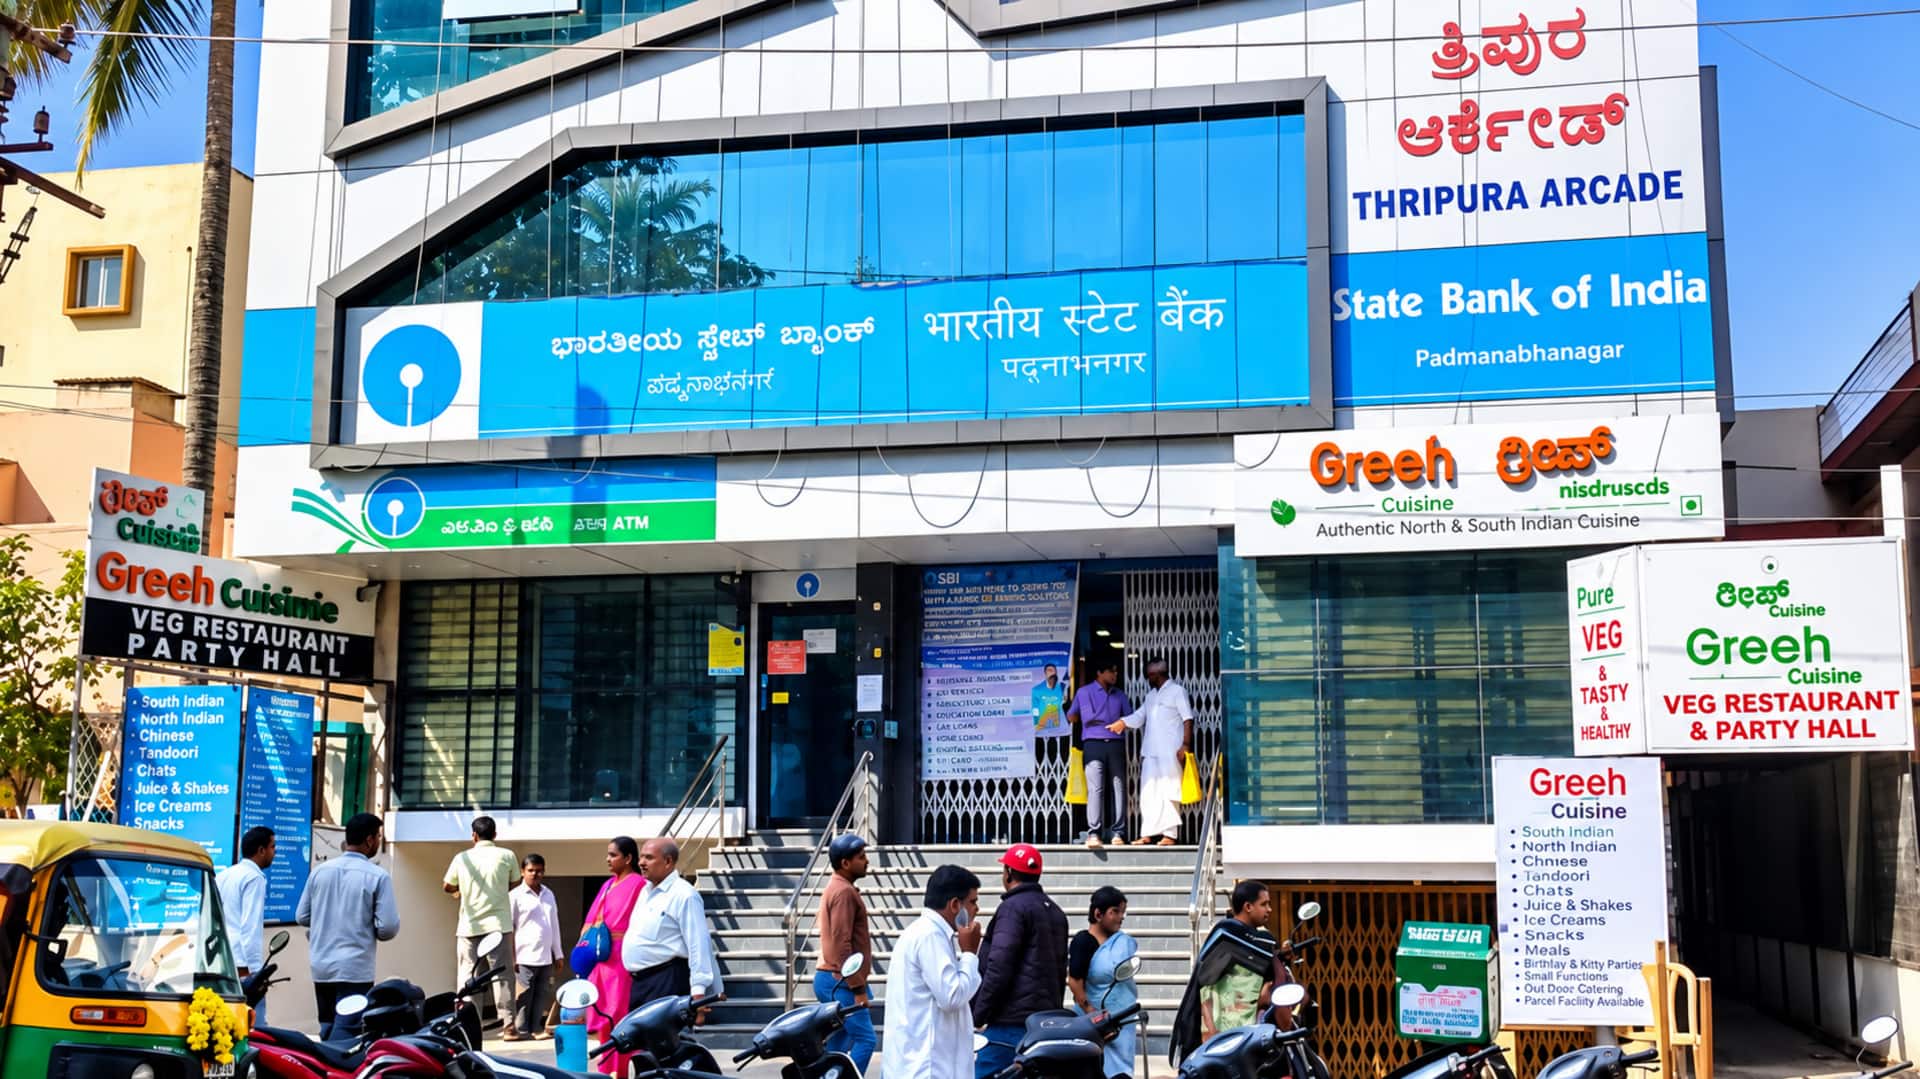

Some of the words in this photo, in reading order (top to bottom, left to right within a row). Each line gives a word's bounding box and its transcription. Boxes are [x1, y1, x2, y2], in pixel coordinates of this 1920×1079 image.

[1352, 180, 1529, 221] THRIPURA
[1540, 170, 1683, 208] ARCADE
[1333, 287, 1424, 321] State
[1440, 278, 1540, 317] Bank
[1551, 274, 1592, 310] of
[1610, 269, 1707, 308] India
[924, 296, 1044, 342] भारतीय
[1059, 290, 1139, 336] स्टेट
[1157, 285, 1227, 332] बैंक
[551, 328, 682, 359] ಭಾರತೀಯ
[1415, 343, 1625, 368] Padmanabhanagar
[1310, 435, 1455, 488] Greeh
[1381, 495, 1454, 514] Cuisine
[612, 515, 649, 530] ATM
[1316, 520, 1395, 539] Authentic
[1400, 518, 1446, 535] North
[1451, 518, 1463, 533] &
[1468, 516, 1516, 533] South
[1522, 513, 1573, 531] Indian
[1577, 513, 1640, 529] Cuisine
[96, 551, 214, 606] Greeh
[937, 572, 960, 585] SBI
[1577, 585, 1614, 609] Pure
[1768, 603, 1826, 618] Cuisine
[131, 607, 185, 633] VEG
[193, 615, 349, 656] RESTAURANT
[1582, 619, 1622, 652] VEG
[1686, 625, 1831, 666] Greeh
[127, 632, 246, 668] PARTY
[262, 650, 342, 678] HALL
[1599, 665, 1607, 681] &
[1787, 667, 1862, 685] Cuisine
[142, 695, 180, 709] South
[184, 694, 225, 708] Indian
[1580, 683, 1629, 705] TASTY
[1663, 694, 1717, 715] VEG
[1724, 690, 1900, 713] RESTAURANT
[140, 713, 178, 726] North
[182, 711, 225, 725] Indian
[1600, 706, 1609, 721] &
[139, 729, 194, 743] Chinese
[1580, 722, 1631, 741] HEALTHY
[1690, 721, 1708, 741] &
[1716, 719, 1800, 740] PARTY
[1807, 718, 1876, 738] HALL
[139, 745, 199, 760] Tandoori
[137, 763, 177, 778] Chats
[134, 781, 168, 796] Juice
[171, 781, 182, 795] &
[184, 781, 230, 795] Shakes
[1530, 767, 1627, 797] Greeh
[134, 799, 155, 813] Ice
[159, 799, 212, 813] Creams
[1551, 802, 1627, 819] Cuisine
[133, 816, 185, 830] Snacks
[1522, 825, 1565, 838] South
[1569, 825, 1614, 838] Indian
[1522, 841, 1566, 852] North
[1570, 841, 1617, 852] Indian
[1524, 870, 1590, 882] Tandoori
[1523, 884, 1574, 897] Chats
[1523, 899, 1562, 911] Juice
[1566, 899, 1577, 911] &
[1580, 899, 1633, 911] Shakes
[1524, 914, 1546, 926] Ice
[1550, 914, 1606, 926] Creams
[1524, 929, 1585, 941] Snacks
[1524, 944, 1571, 956] Meals
[1569, 959, 1578, 969] &
[1580, 959, 1605, 971] Kitty
[1524, 971, 1553, 982] Small
[1556, 971, 1609, 982] Functions
[1524, 983, 1545, 994] Out
[1577, 983, 1624, 996] Catering
[1524, 996, 1555, 1006] Parcel
[1597, 996, 1645, 1008] Available
